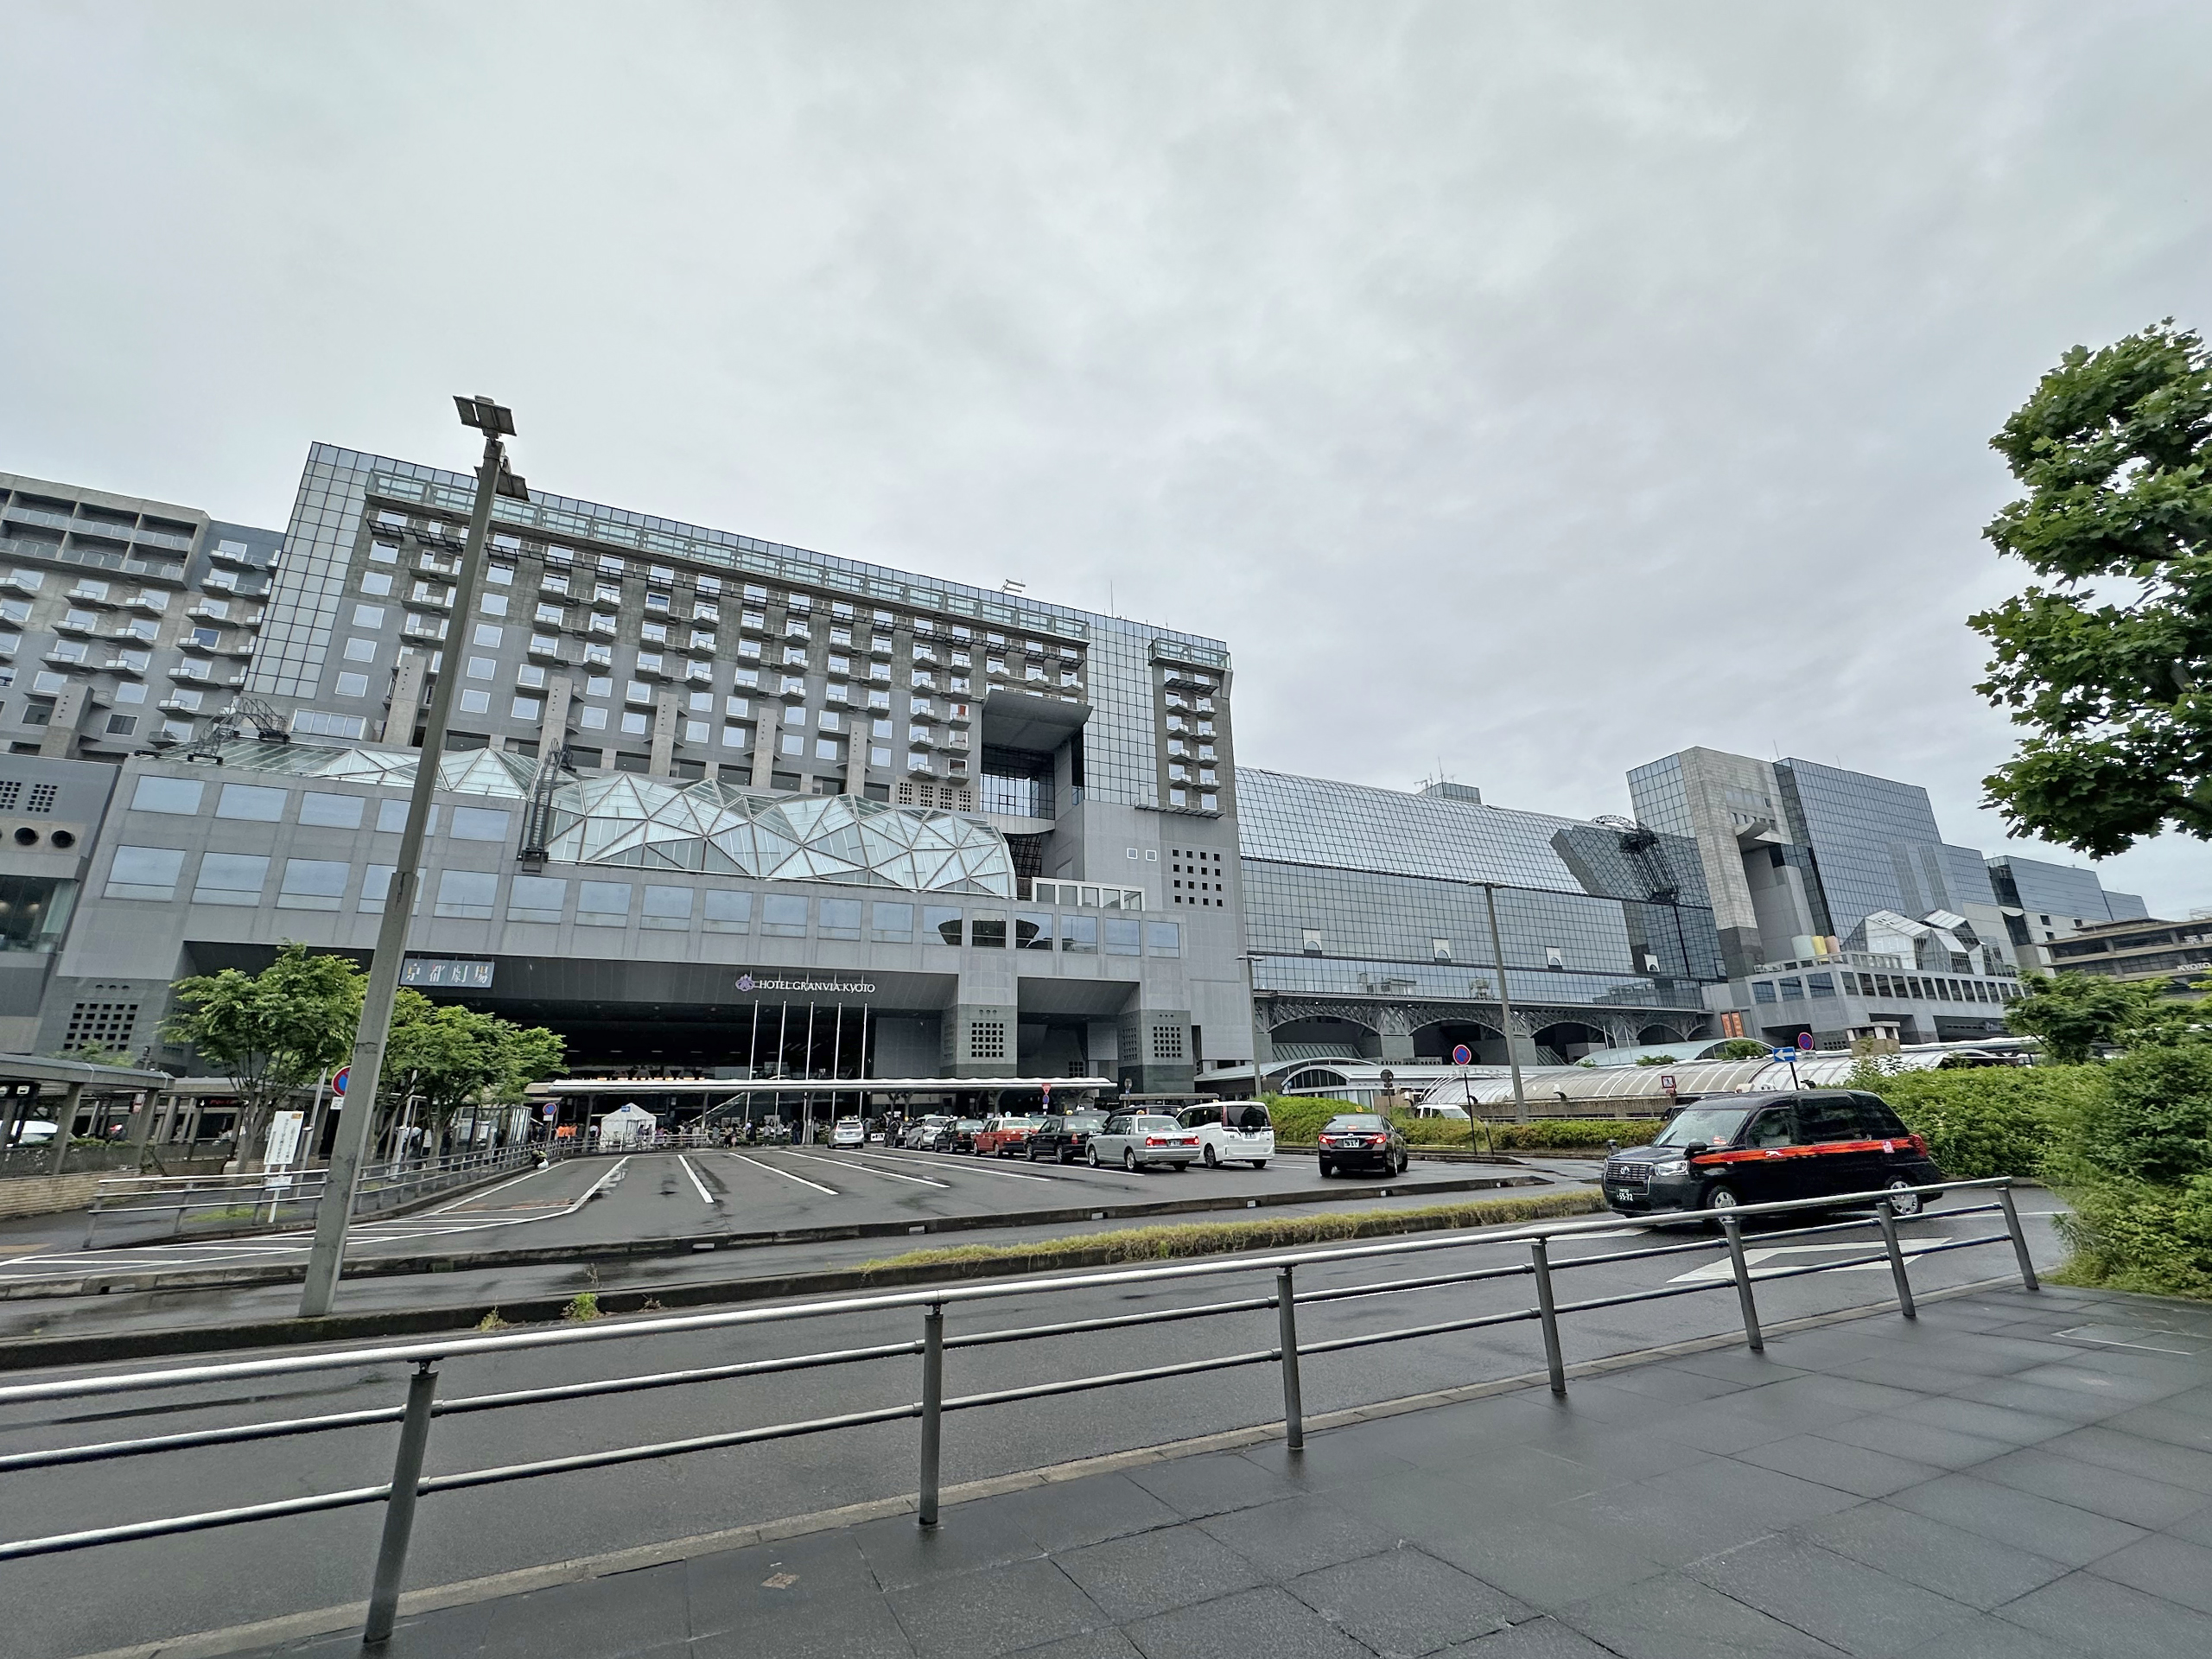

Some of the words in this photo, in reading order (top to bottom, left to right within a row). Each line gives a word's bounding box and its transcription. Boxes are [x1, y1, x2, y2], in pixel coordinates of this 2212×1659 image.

[405, 963, 490, 984] 京都劇場
[2177, 962, 2211, 972] KYOTO
[759, 980, 790, 990] HOTEL
[792, 981, 840, 991] GRANVIA
[842, 982, 876, 993] KYOTO
